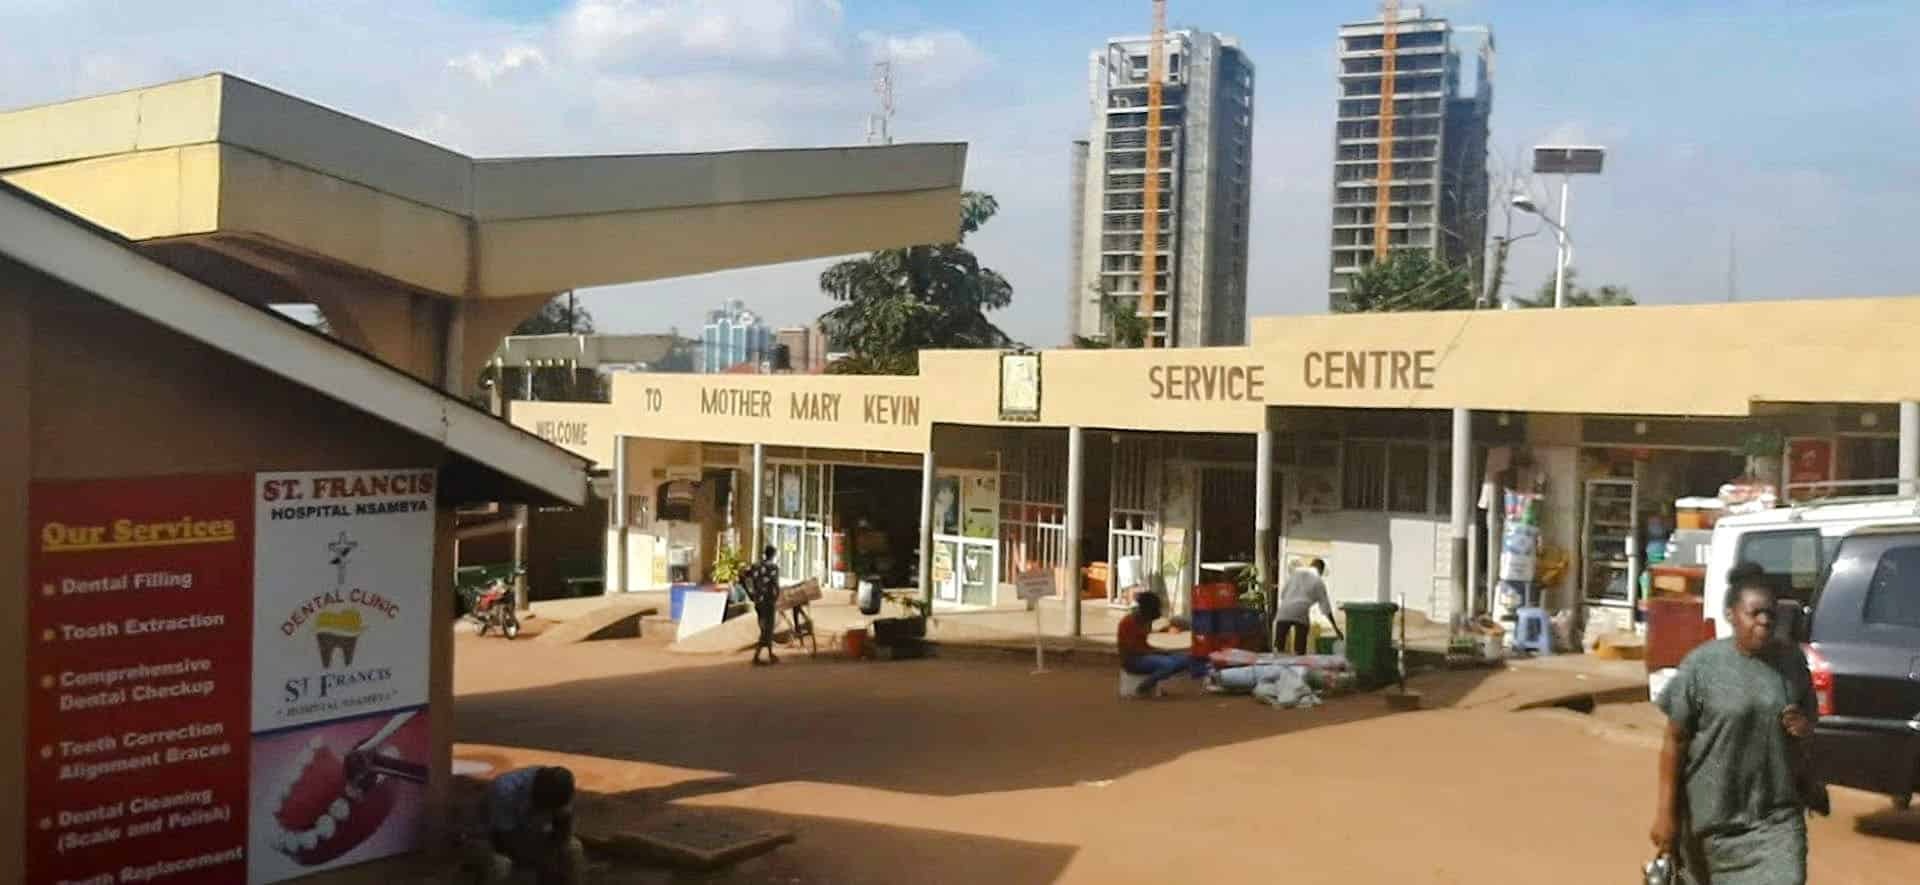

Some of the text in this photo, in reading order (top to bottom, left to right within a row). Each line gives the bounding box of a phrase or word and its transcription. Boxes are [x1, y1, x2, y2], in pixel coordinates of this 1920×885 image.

[536, 350, 1436, 445] WELCOME TO MOTHER MARY KEVIN SERVICE CENTRE
[264, 473, 433, 501] ST. FRANCIS
[272, 500, 428, 520] HOSPITAL NSAMBYA
[42, 515, 236, 548] Our Services
[62, 571, 193, 594] Dental Filling
[61, 613, 225, 640] Tooth Extraction
[281, 588, 400, 636] DENTAL CLINIC
[60, 657, 212, 688] Comprehensive
[60, 678, 215, 711] Dental Checkup
[122, 722, 224, 748] Correction
[58, 743, 231, 781] Alignment Braces
[58, 789, 213, 827] Dental Cleaning
[57, 803, 231, 855] (Scale and Polish)
[119, 845, 244, 882] Replacement
